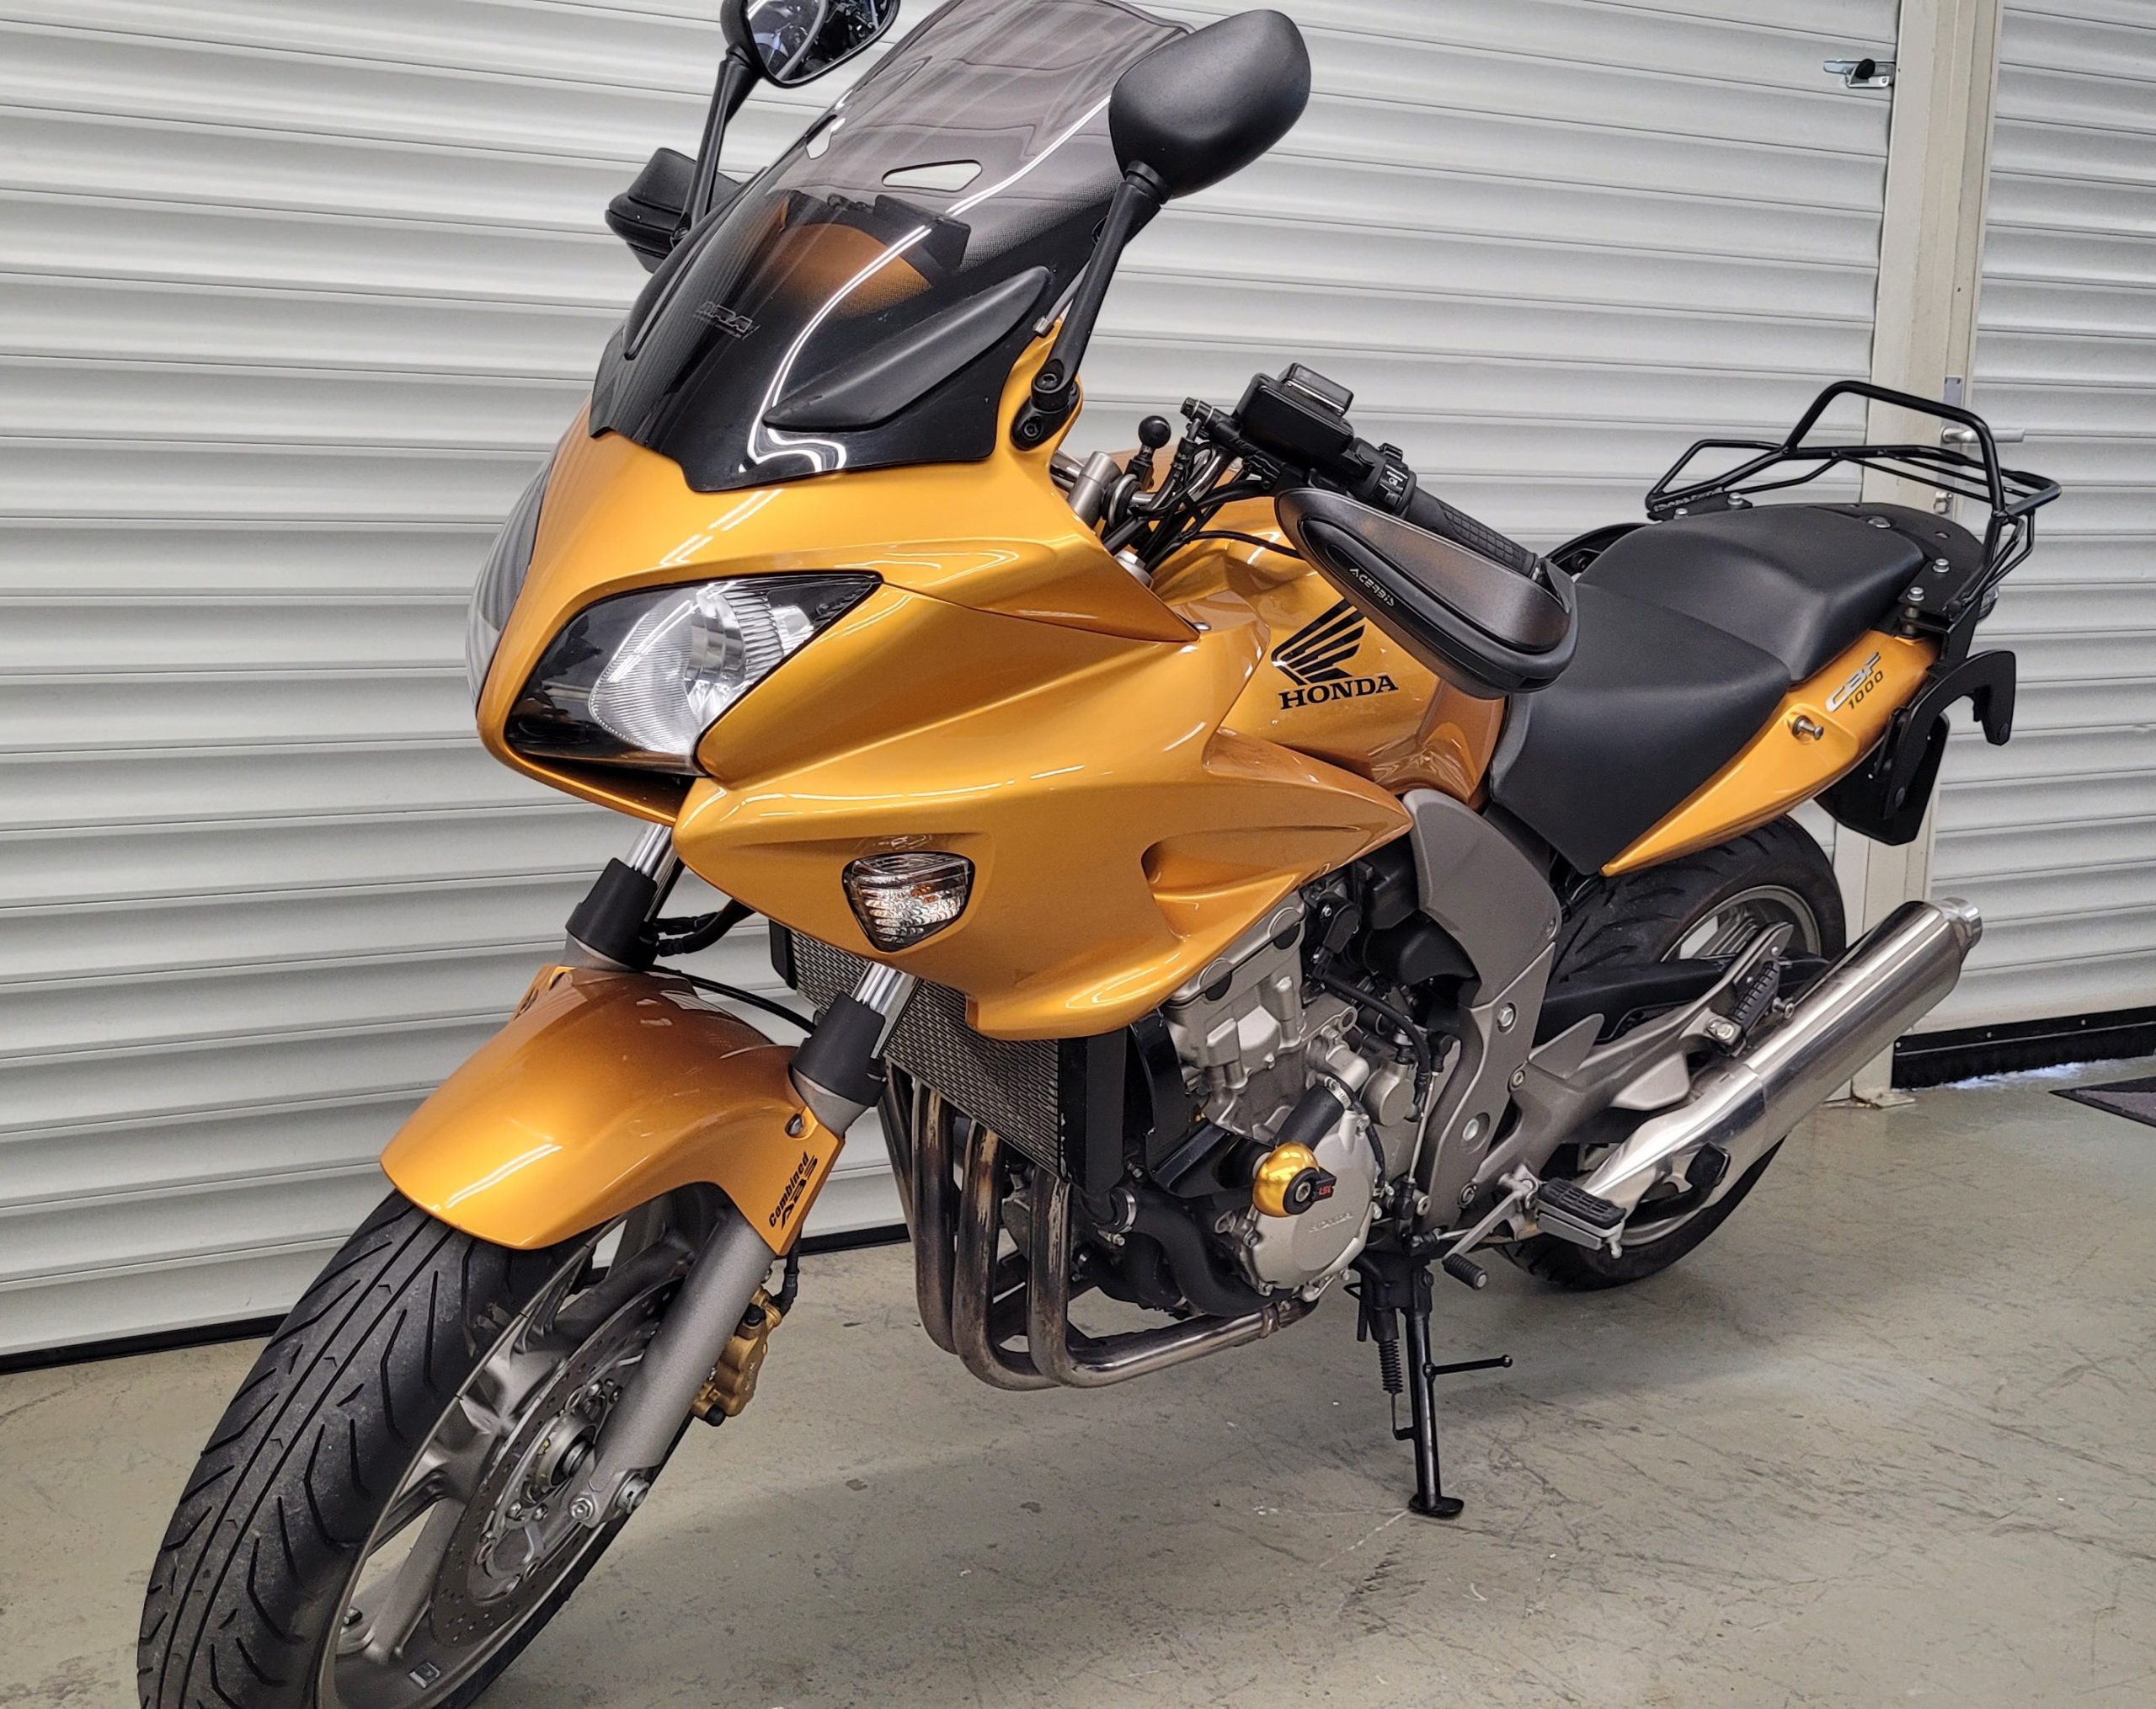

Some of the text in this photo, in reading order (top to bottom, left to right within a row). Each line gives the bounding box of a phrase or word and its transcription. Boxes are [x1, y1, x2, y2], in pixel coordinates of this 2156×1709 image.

[1278, 675, 1399, 710] HONDA
[1825, 652, 1881, 713] CBF
[1848, 670, 1884, 709] 1000
[769, 1151, 809, 1228] Combined
[782, 1155, 818, 1231] ABS
